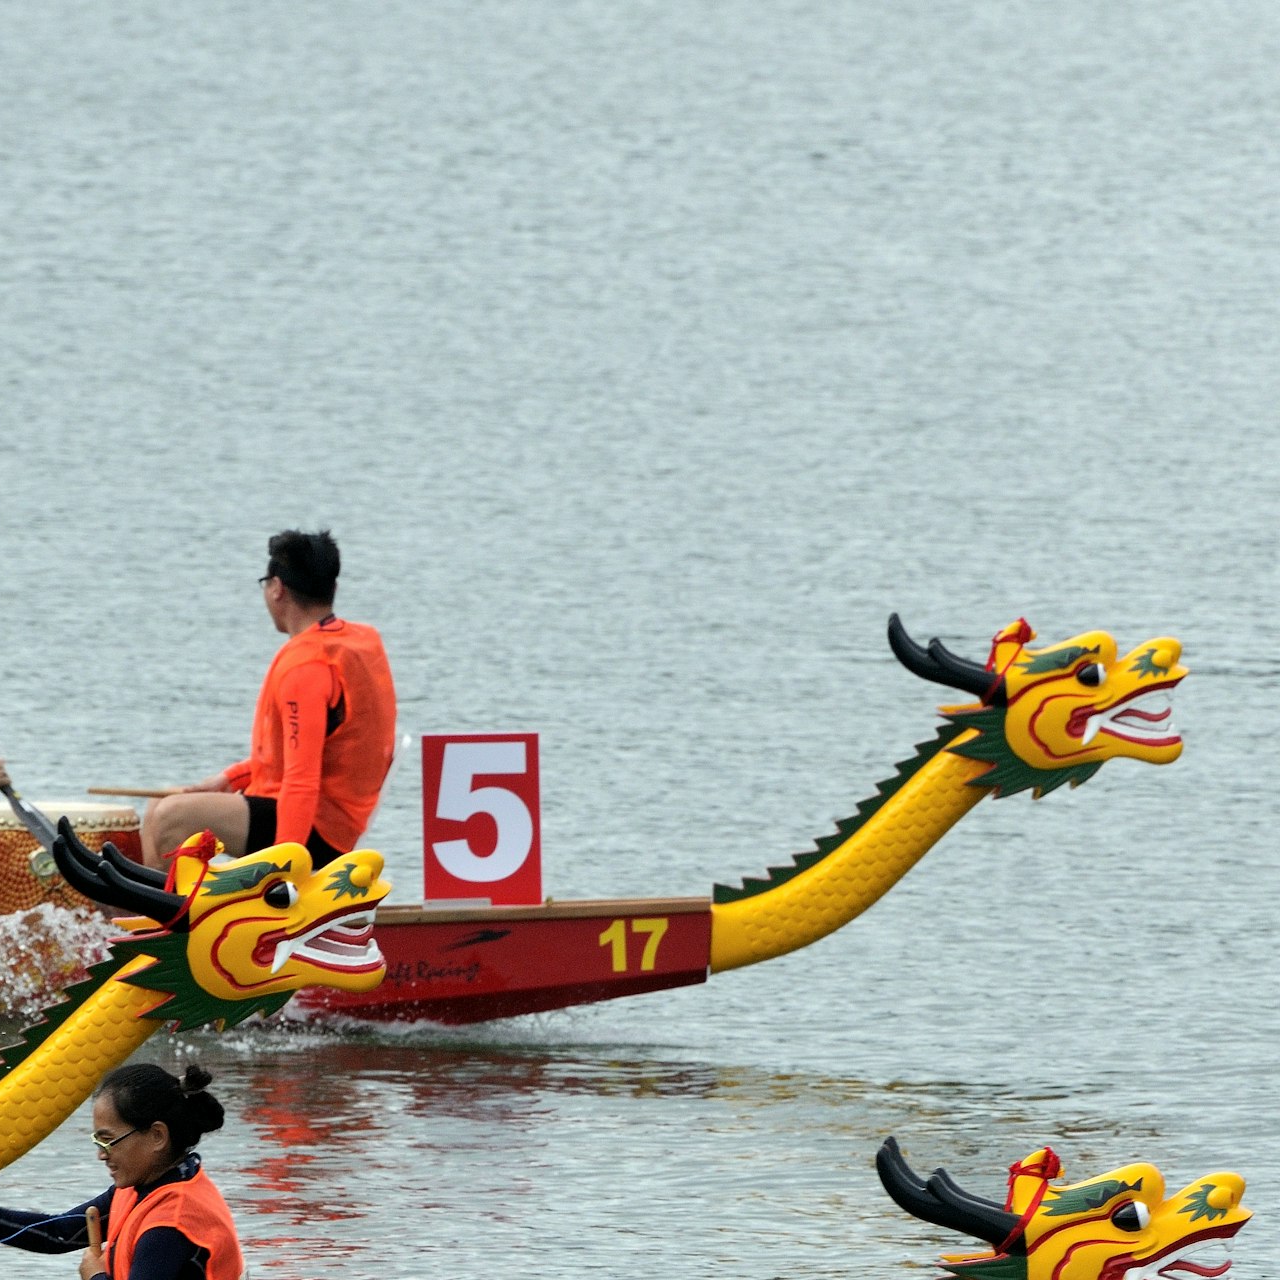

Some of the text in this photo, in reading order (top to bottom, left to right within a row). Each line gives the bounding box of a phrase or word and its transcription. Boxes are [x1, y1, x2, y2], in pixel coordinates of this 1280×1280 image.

[286, 701, 299, 751] PIPC
[432, 741, 533, 883] 5
[599, 918, 669, 972] 17
